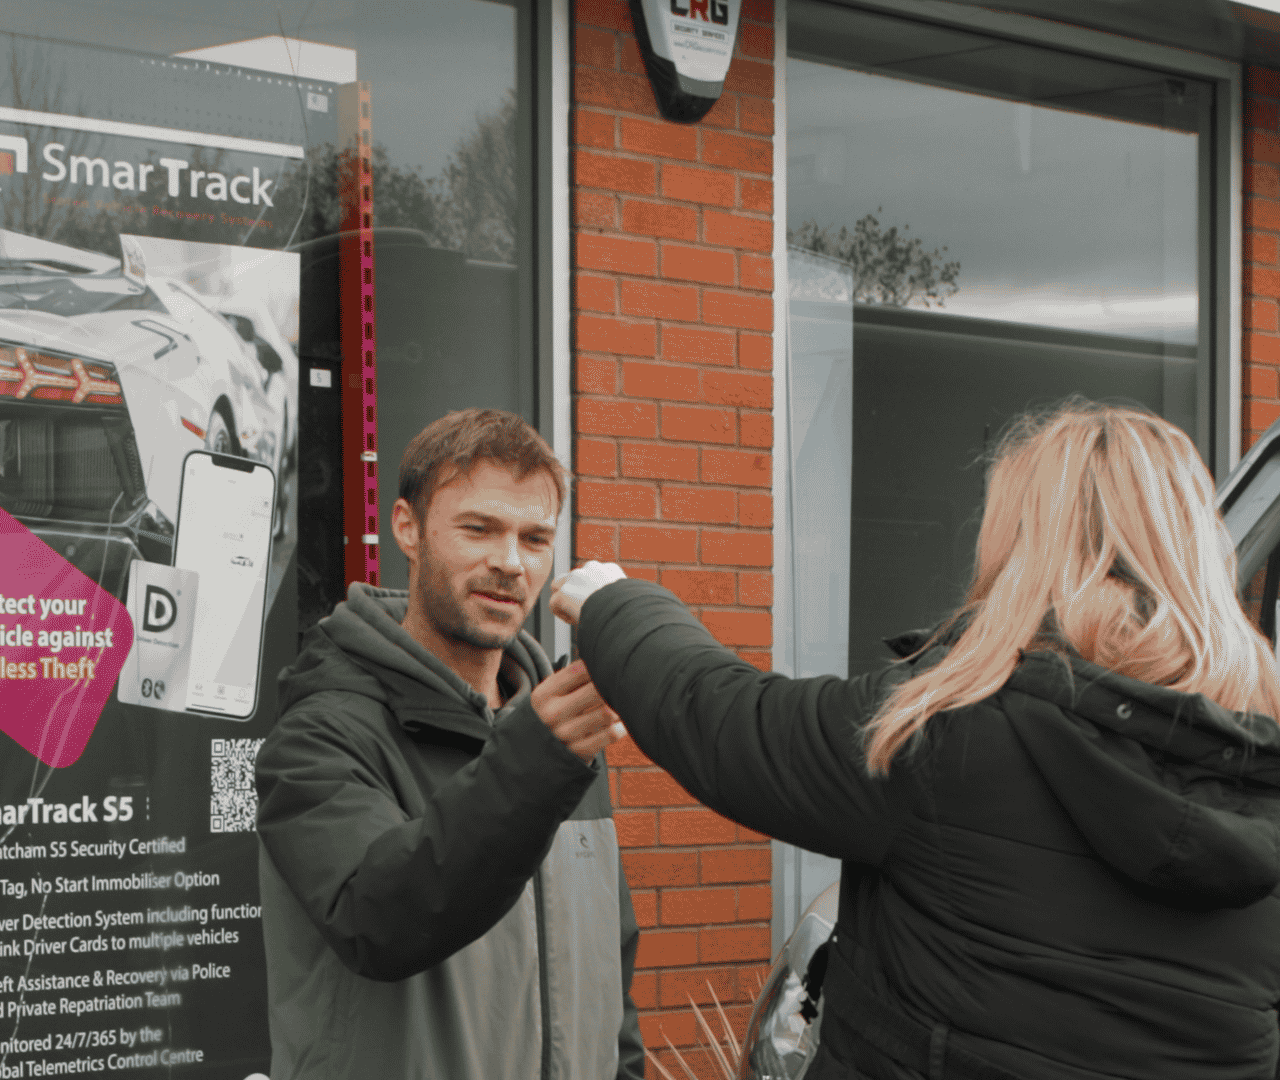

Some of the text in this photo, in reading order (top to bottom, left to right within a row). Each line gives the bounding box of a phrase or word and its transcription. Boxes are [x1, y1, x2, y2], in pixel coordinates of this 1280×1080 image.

[40, 597, 87, 621] your
[37, 625, 113, 653] against
[40, 656, 95, 680] Theft
[103, 796, 134, 822] S5
[50, 841, 67, 858] S5
[71, 839, 126, 859] Security
[129, 836, 186, 855] Certified
[0, 878, 28, 899] Tag,
[31, 877, 52, 895] No
[55, 875, 89, 893] Start
[91, 871, 171, 892] Immobiliser
[174, 871, 220, 890] Option
[22, 911, 92, 931] Detection
[95, 910, 144, 930] System
[147, 905, 208, 925] including
[24, 937, 66, 956] Driver
[70, 935, 108, 954] Cards
[111, 934, 126, 950] to
[129, 932, 184, 951] multiple
[187, 928, 239, 946] vehicles
[17, 971, 91, 992] Assistance
[93, 970, 104, 987] &
[106, 967, 167, 987] Recovery
[170, 965, 190, 981] via
[192, 962, 231, 980] Police
[8, 998, 57, 1018] Private
[60, 995, 143, 1017] Repatriation
[145, 991, 182, 1009] Team
[55, 1029, 117, 1051] 24/7/365
[120, 1028, 138, 1047] by
[140, 1026, 163, 1043] the
[26, 1056, 105, 1078] Telemetrics
[108, 1052, 158, 1071] Control
[160, 1048, 204, 1066] Centre
